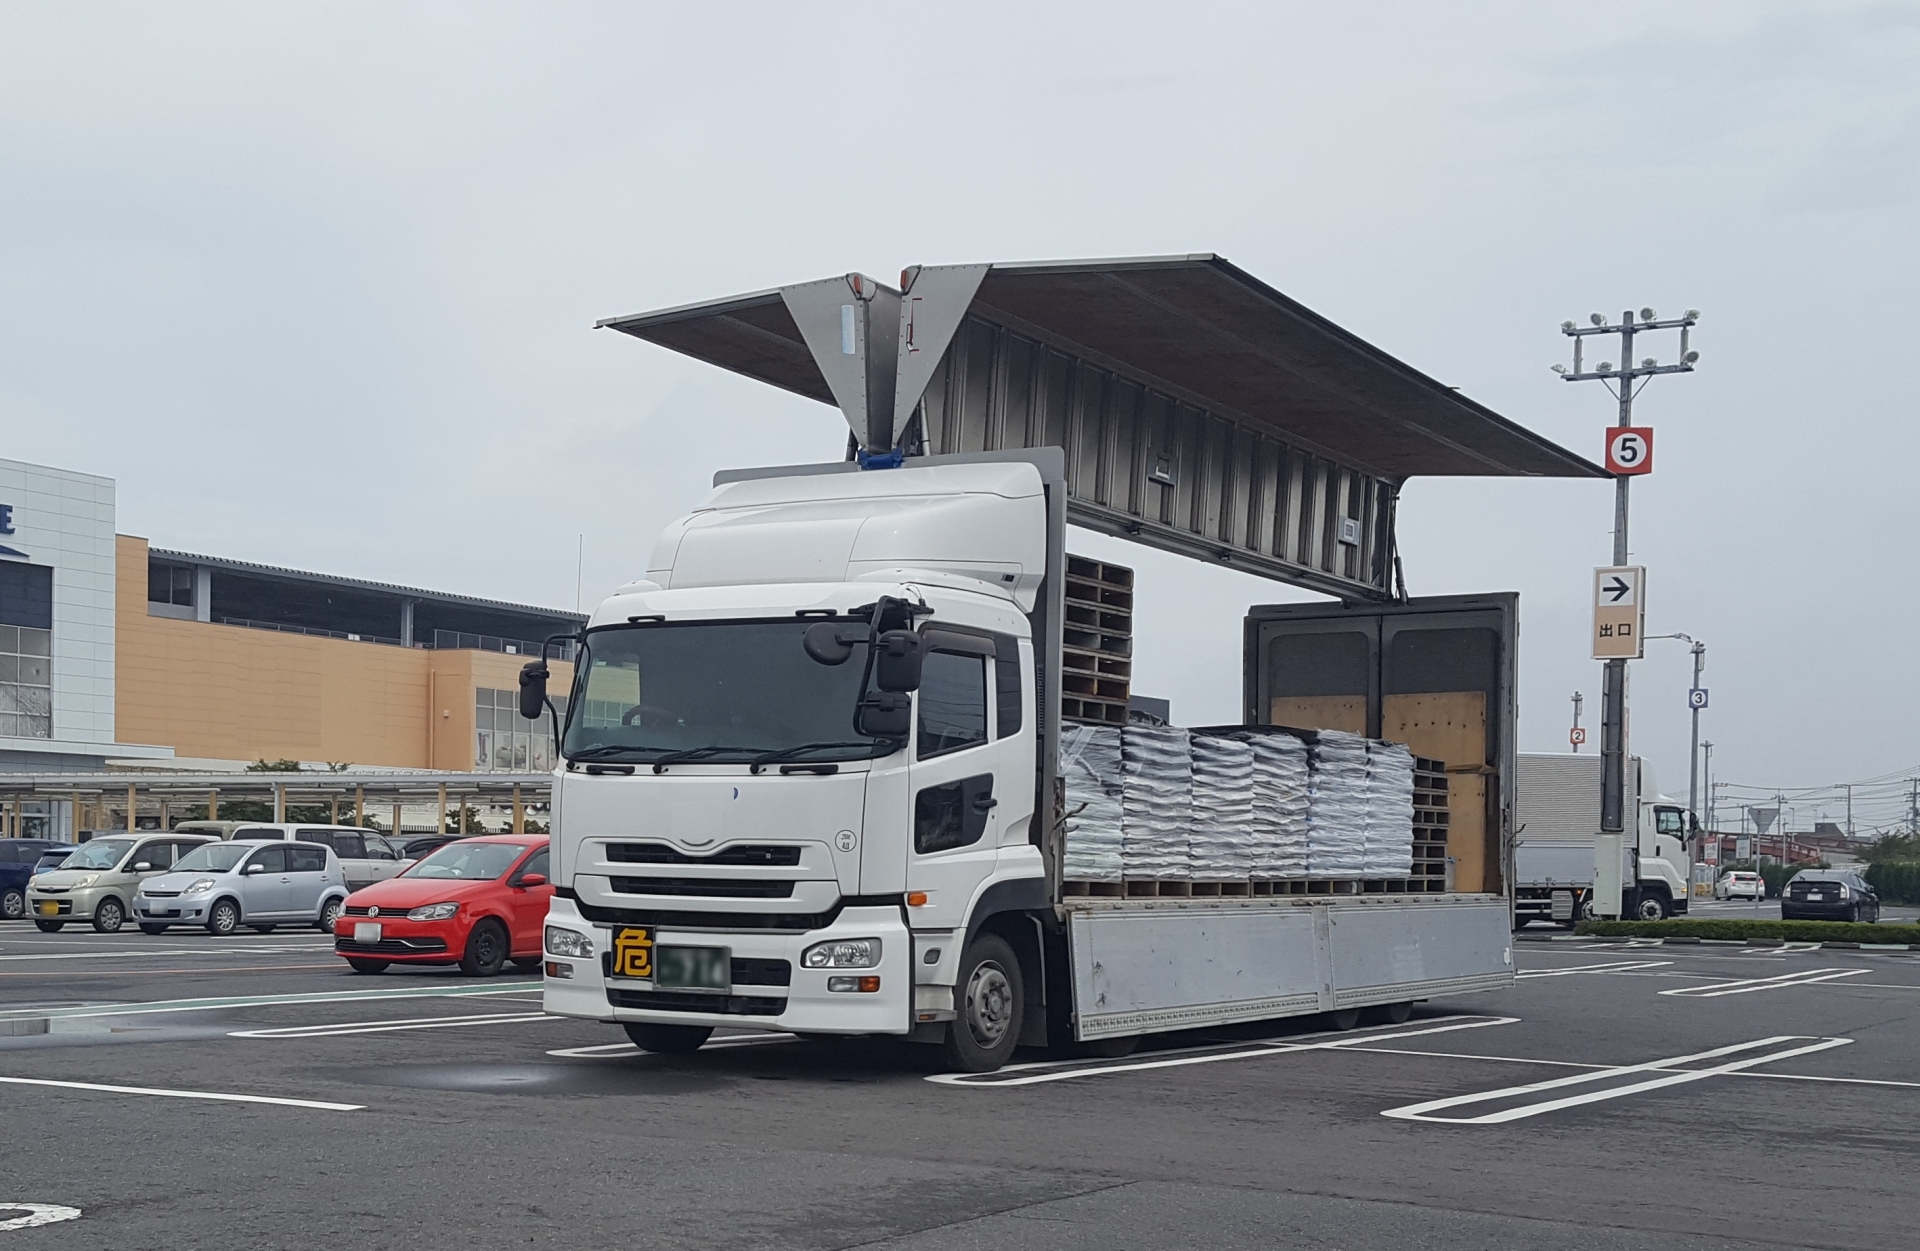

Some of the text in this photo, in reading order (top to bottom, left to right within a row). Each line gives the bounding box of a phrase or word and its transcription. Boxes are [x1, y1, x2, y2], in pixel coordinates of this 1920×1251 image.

[1620, 437, 1638, 463] 5
[1600, 623, 1631, 638] 出口
[1694, 692, 1703, 704] 3
[1574, 731, 1581, 741] 2
[614, 927, 653, 976] 危
